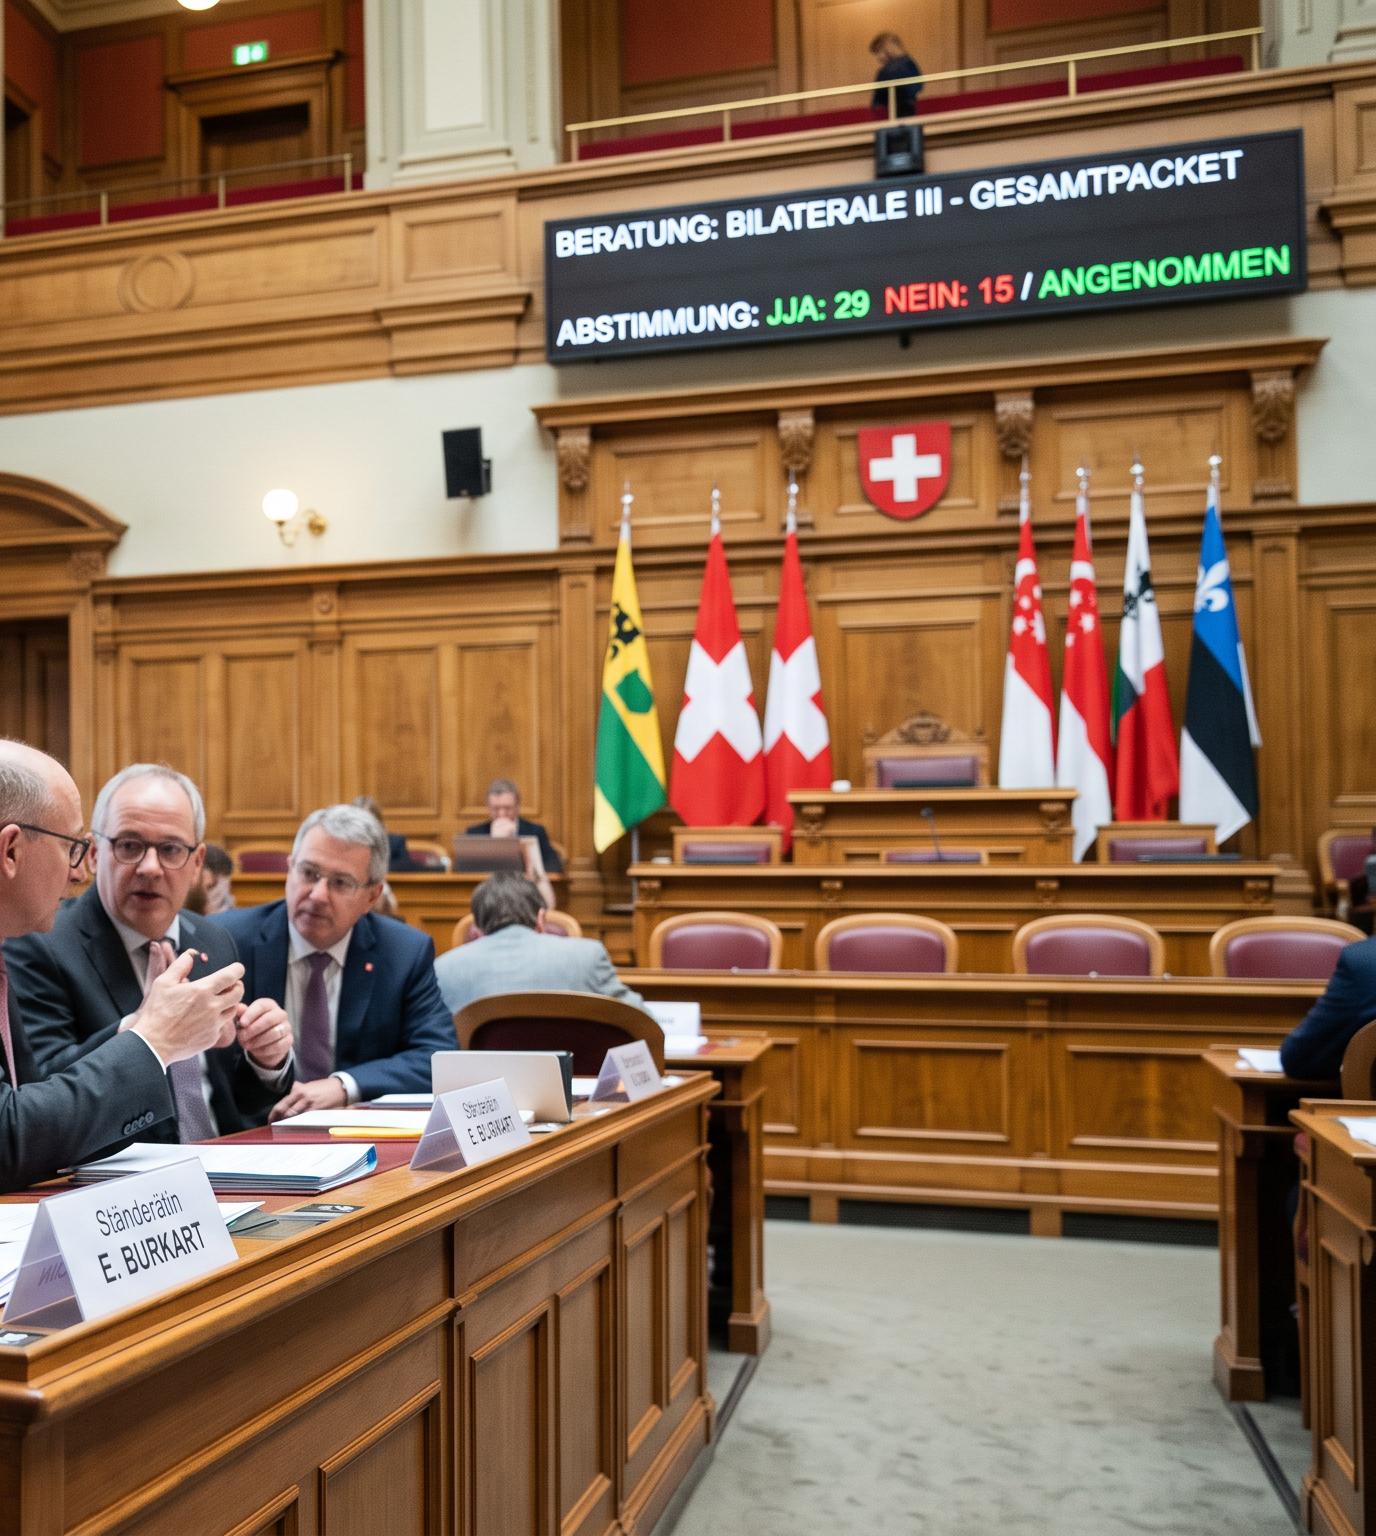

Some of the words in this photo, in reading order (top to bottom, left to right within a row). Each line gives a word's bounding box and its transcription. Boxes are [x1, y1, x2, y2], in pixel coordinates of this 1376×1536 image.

[555, 213, 720, 258] BERATUNG:
[725, 189, 909, 239] BILATERALE
[914, 186, 943, 217] III
[969, 149, 1244, 211] GESAMTPACKET
[555, 300, 760, 347] ABSTIMMUNG:
[765, 294, 827, 327] JJA:
[833, 289, 871, 320] 29
[884, 279, 969, 315] NEIN:
[978, 274, 1015, 305] 15
[1020, 271, 1034, 301] /
[1037, 244, 1291, 300] ANGENOMMEN
[95, 1190, 183, 1236] Ständerätin
[97, 1252, 122, 1284] E.
[120, 1221, 205, 1275] BURKART
